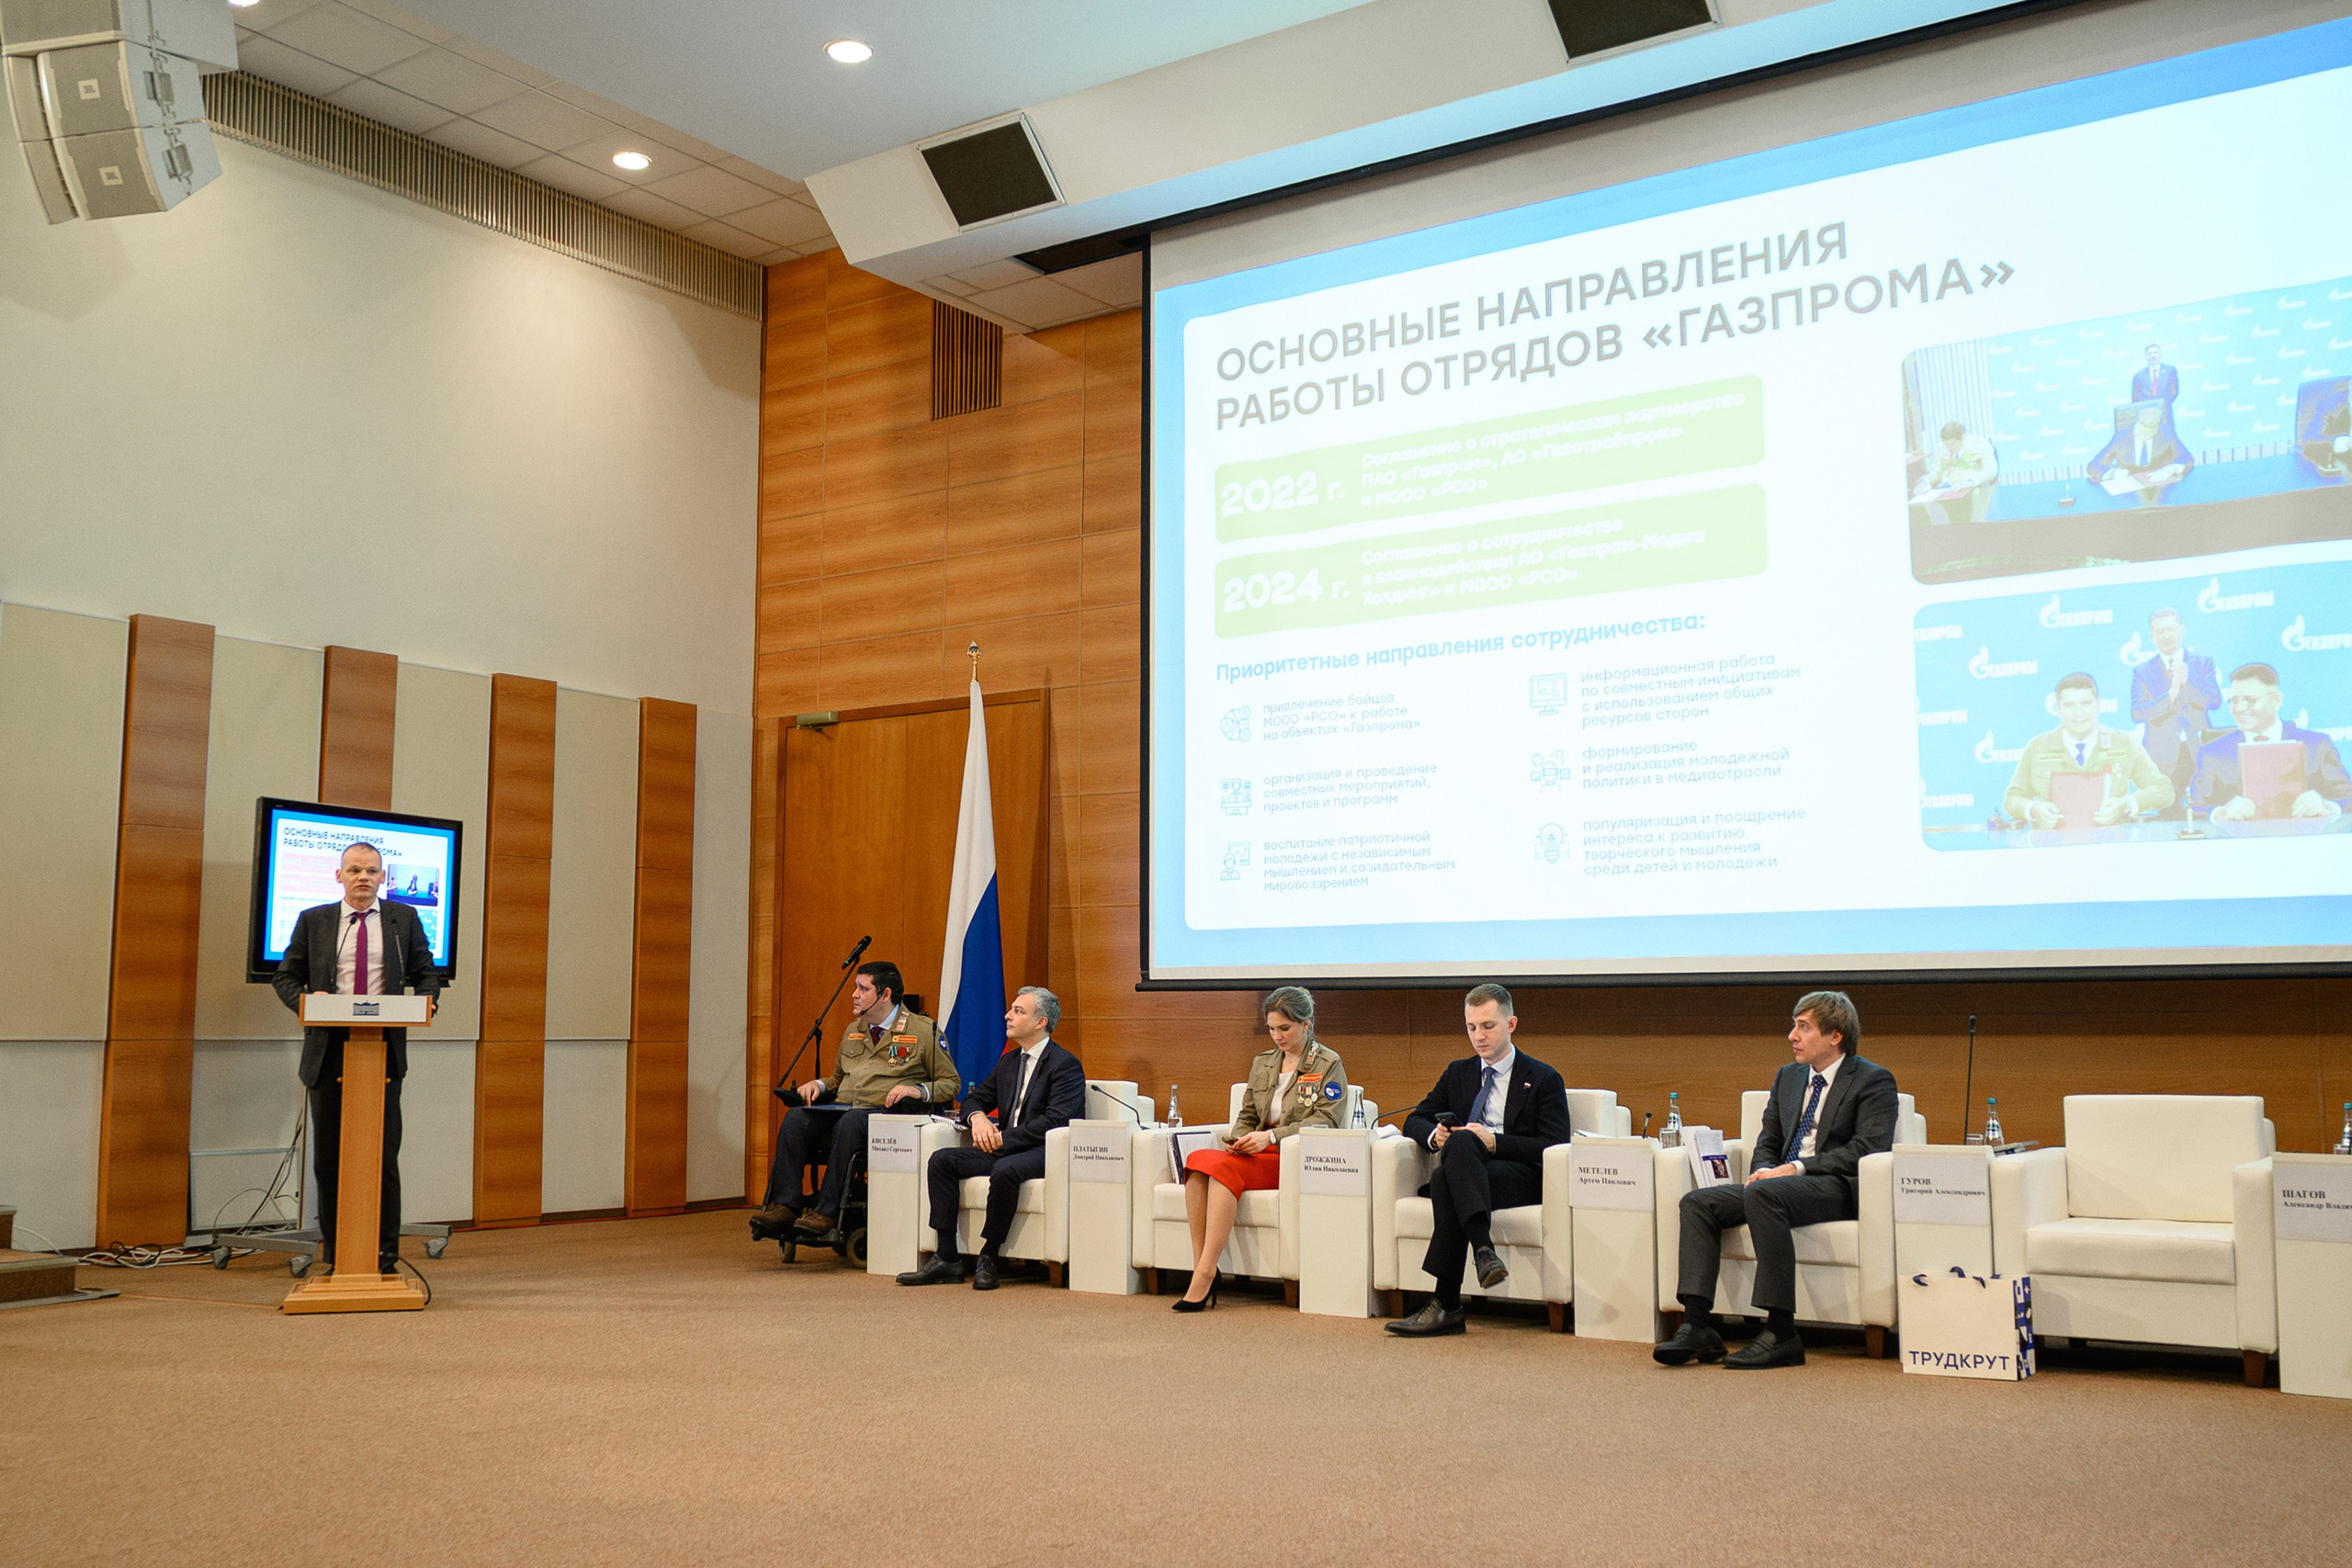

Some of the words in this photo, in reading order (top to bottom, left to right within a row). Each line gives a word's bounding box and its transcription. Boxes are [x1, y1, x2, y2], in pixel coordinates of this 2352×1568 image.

[1217, 300, 1461, 382] ОСНОВНЫЕ
[1477, 220, 1848, 331] НАПРАВЛЕНИЯ
[1217, 372, 1386, 431] РАБОТЫ
[1400, 323, 1623, 396] ОТРЯДОВ
[1643, 257, 2016, 349] «ГАЗПРОМА»
[1465, 438, 1477, 451] о
[1362, 469, 1396, 487] ПАО
[1501, 448, 1526, 467] АО
[1221, 471, 1319, 517] 2022
[1327, 480, 1345, 502] г.
[1362, 495, 1372, 507] и
[1375, 486, 1426, 506] МООО
[1430, 477, 1489, 497] «РСО»
[1361, 541, 1464, 565] Соглашение
[1466, 539, 1478, 552] о
[1362, 574, 1372, 586] и
[1517, 549, 1544, 566] АО
[1223, 567, 1323, 612] 2024
[1332, 580, 1350, 599] г.
[1363, 586, 1440, 606] Холдинг»
[1444, 583, 1455, 596] и
[1460, 574, 1513, 594] МООО
[1518, 567, 1578, 586] «РСО»
[1216, 650, 1361, 684] Приоритетные
[1365, 635, 1505, 667] направления
[1510, 614, 1707, 649] сотрудничества:
[1580, 660, 1715, 683] информационная
[1719, 654, 1776, 672] работа
[1581, 686, 1600, 698] по
[1603, 676, 1694, 695] совместным
[1698, 666, 1802, 686] инициативам
[1263, 695, 1344, 715] привлечение
[1347, 693, 1396, 707] бойцов
[1582, 702, 1590, 712] с
[1594, 692, 1719, 712] использованием
[1724, 683, 1774, 700] общих
[1263, 713, 1299, 728] МООО
[1303, 710, 1346, 724] «РСО»
[1350, 712, 1358, 720] к
[1362, 705, 1408, 721] работе
[1582, 710, 1652, 729] ресурсов
[1656, 705, 1710, 722] сторон
[1263, 731, 1278, 741] на
[1281, 725, 1338, 739] объектах
[1343, 719, 1421, 735] «Газпрома»
[1583, 739, 1698, 761] формирование
[1583, 763, 1591, 774] и
[1596, 755, 1685, 776] реализация
[1689, 746, 1791, 767] молодежной
[1263, 769, 1341, 788] организация
[1345, 770, 1352, 778] и
[1356, 763, 1438, 781] проведение
[1583, 773, 1651, 788] политики
[1656, 774, 1664, 784] в
[1668, 765, 1781, 784] медиаотрасли
[1263, 783, 1336, 799] совместных
[1339, 776, 1430, 794] мероприятий,
[1263, 798, 1320, 815] проектов
[1323, 799, 1330, 808] и
[1334, 794, 1398, 809] программ
[1583, 814, 1697, 833] популяризация
[1702, 814, 1711, 824] и
[1714, 807, 1807, 825] поощрение
[283, 838, 314, 849] РАБОТЫ
[317, 841, 347, 852] ОТРЯДО
[284, 827, 328, 840] ОСНОВНЫЕ
[330, 832, 384, 845] НАПРАВЛЕНИЯ
[1264, 836, 1336, 851] воспитание
[1339, 829, 1430, 847] патриотичной
[1583, 831, 1654, 846] интереса
[1658, 832, 1666, 842] к
[1670, 828, 1746, 846] развитию
[1264, 852, 1329, 864] молодежи
[1330, 852, 1339, 861] с
[1341, 846, 1431, 861] независимым
[1584, 845, 1676, 863] творческого
[1679, 841, 1761, 856] мышления
[1264, 863, 1338, 878] мышлением
[1340, 864, 1348, 874] и
[1351, 859, 1456, 874] созидательным
[1584, 863, 1630, 877] среди
[1634, 859, 1679, 874] детей
[1682, 860, 1691, 871] и
[1696, 855, 1779, 872] молодежи
[1264, 875, 1370, 894] мировоззрением
[1304, 1156, 1346, 1164] ДРОЖЖИНА
[1578, 1166, 1618, 1175] МЕТЕЛЕВ
[1601, 1178, 1636, 1186] Павлович
[1901, 1177, 1931, 1185] ГУРОВ
[2282, 1190, 2326, 1200] ШАГОВ
[2283, 1201, 2324, 1211] Александр
[1908, 1350, 2009, 1371] ТРУДКРУТ
